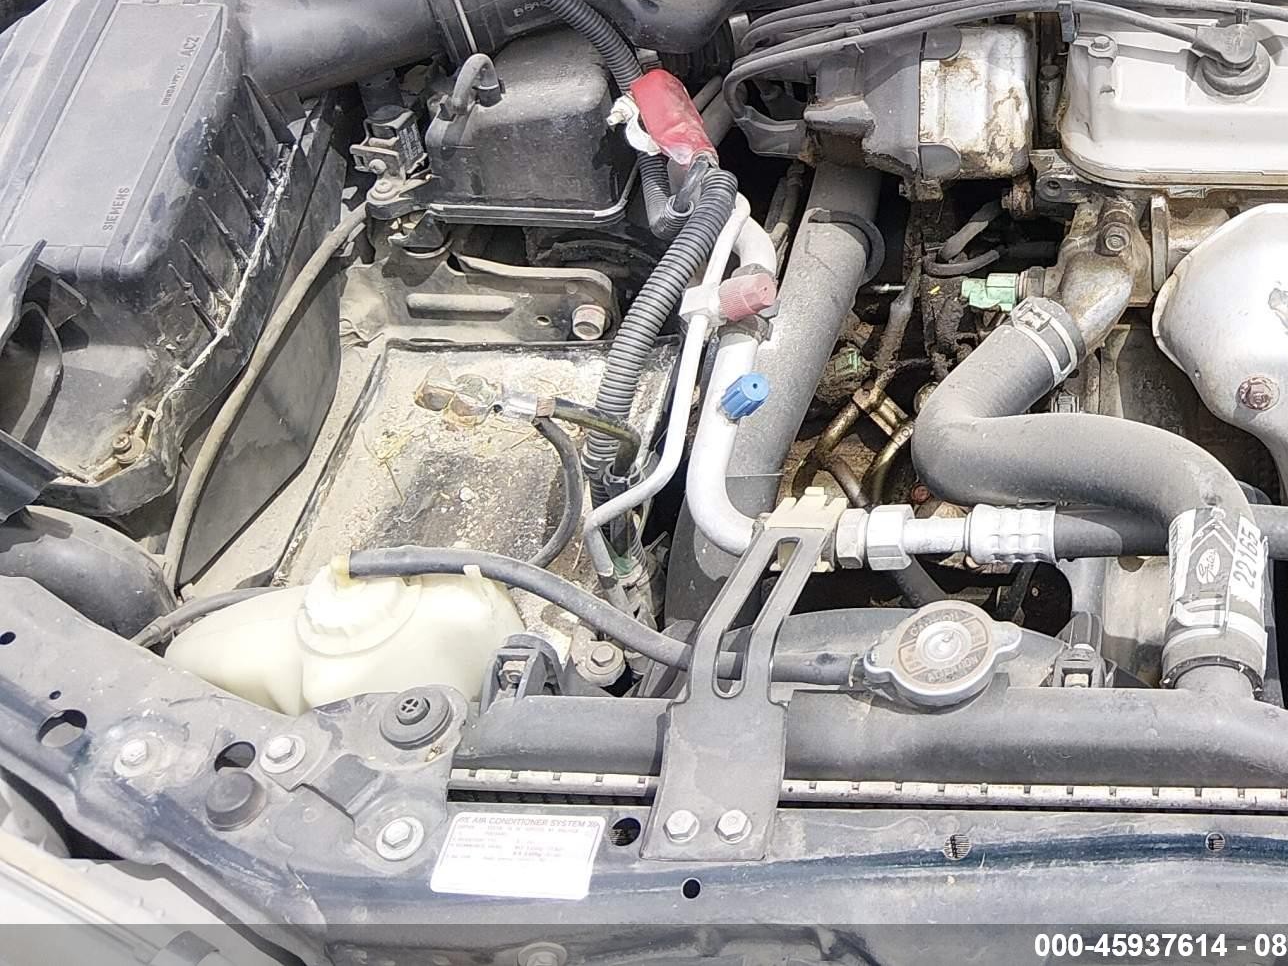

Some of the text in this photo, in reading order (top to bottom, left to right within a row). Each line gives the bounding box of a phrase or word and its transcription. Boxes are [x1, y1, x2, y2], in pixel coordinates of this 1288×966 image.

[102, 186, 130, 231] SIEMENS
[1232, 527, 1257, 590] 22165
[489, 817, 547, 826] CONDITIONER
[551, 819, 587, 828] SYSTEM
